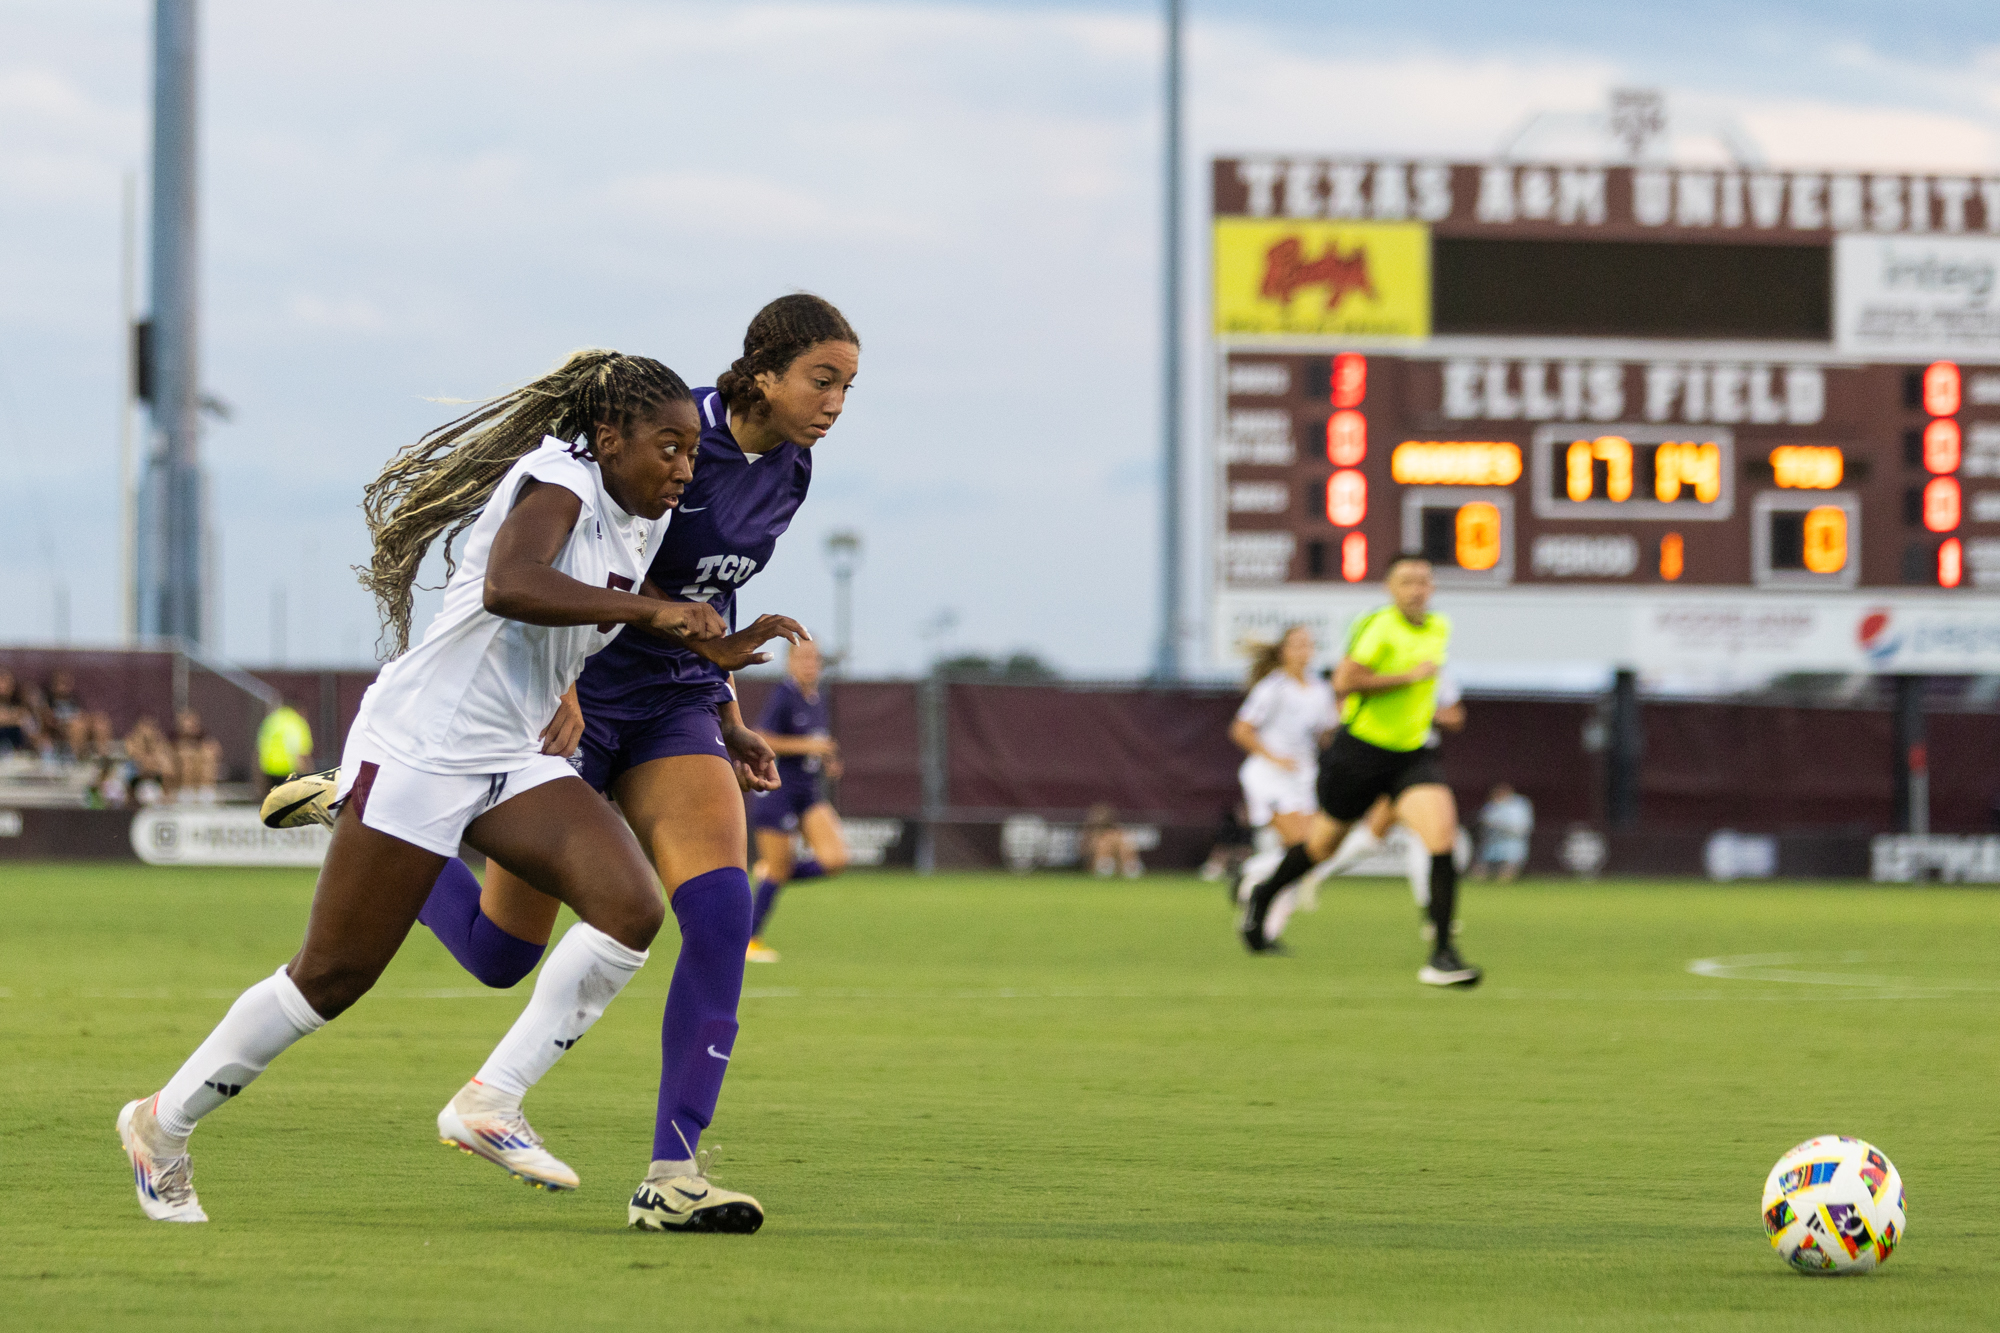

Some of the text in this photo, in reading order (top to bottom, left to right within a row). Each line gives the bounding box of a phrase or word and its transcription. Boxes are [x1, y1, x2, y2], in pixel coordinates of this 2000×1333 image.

[1238, 162, 1453, 222] TEXAS
[1476, 165, 1609, 226] A&M
[1442, 361, 1826, 425] ELLIS FIELD
[1455, 500, 1501, 571] 0
[1659, 531, 1685, 581] 1
[1803, 504, 1848, 574] 0
[694, 554, 757, 584] TCU
